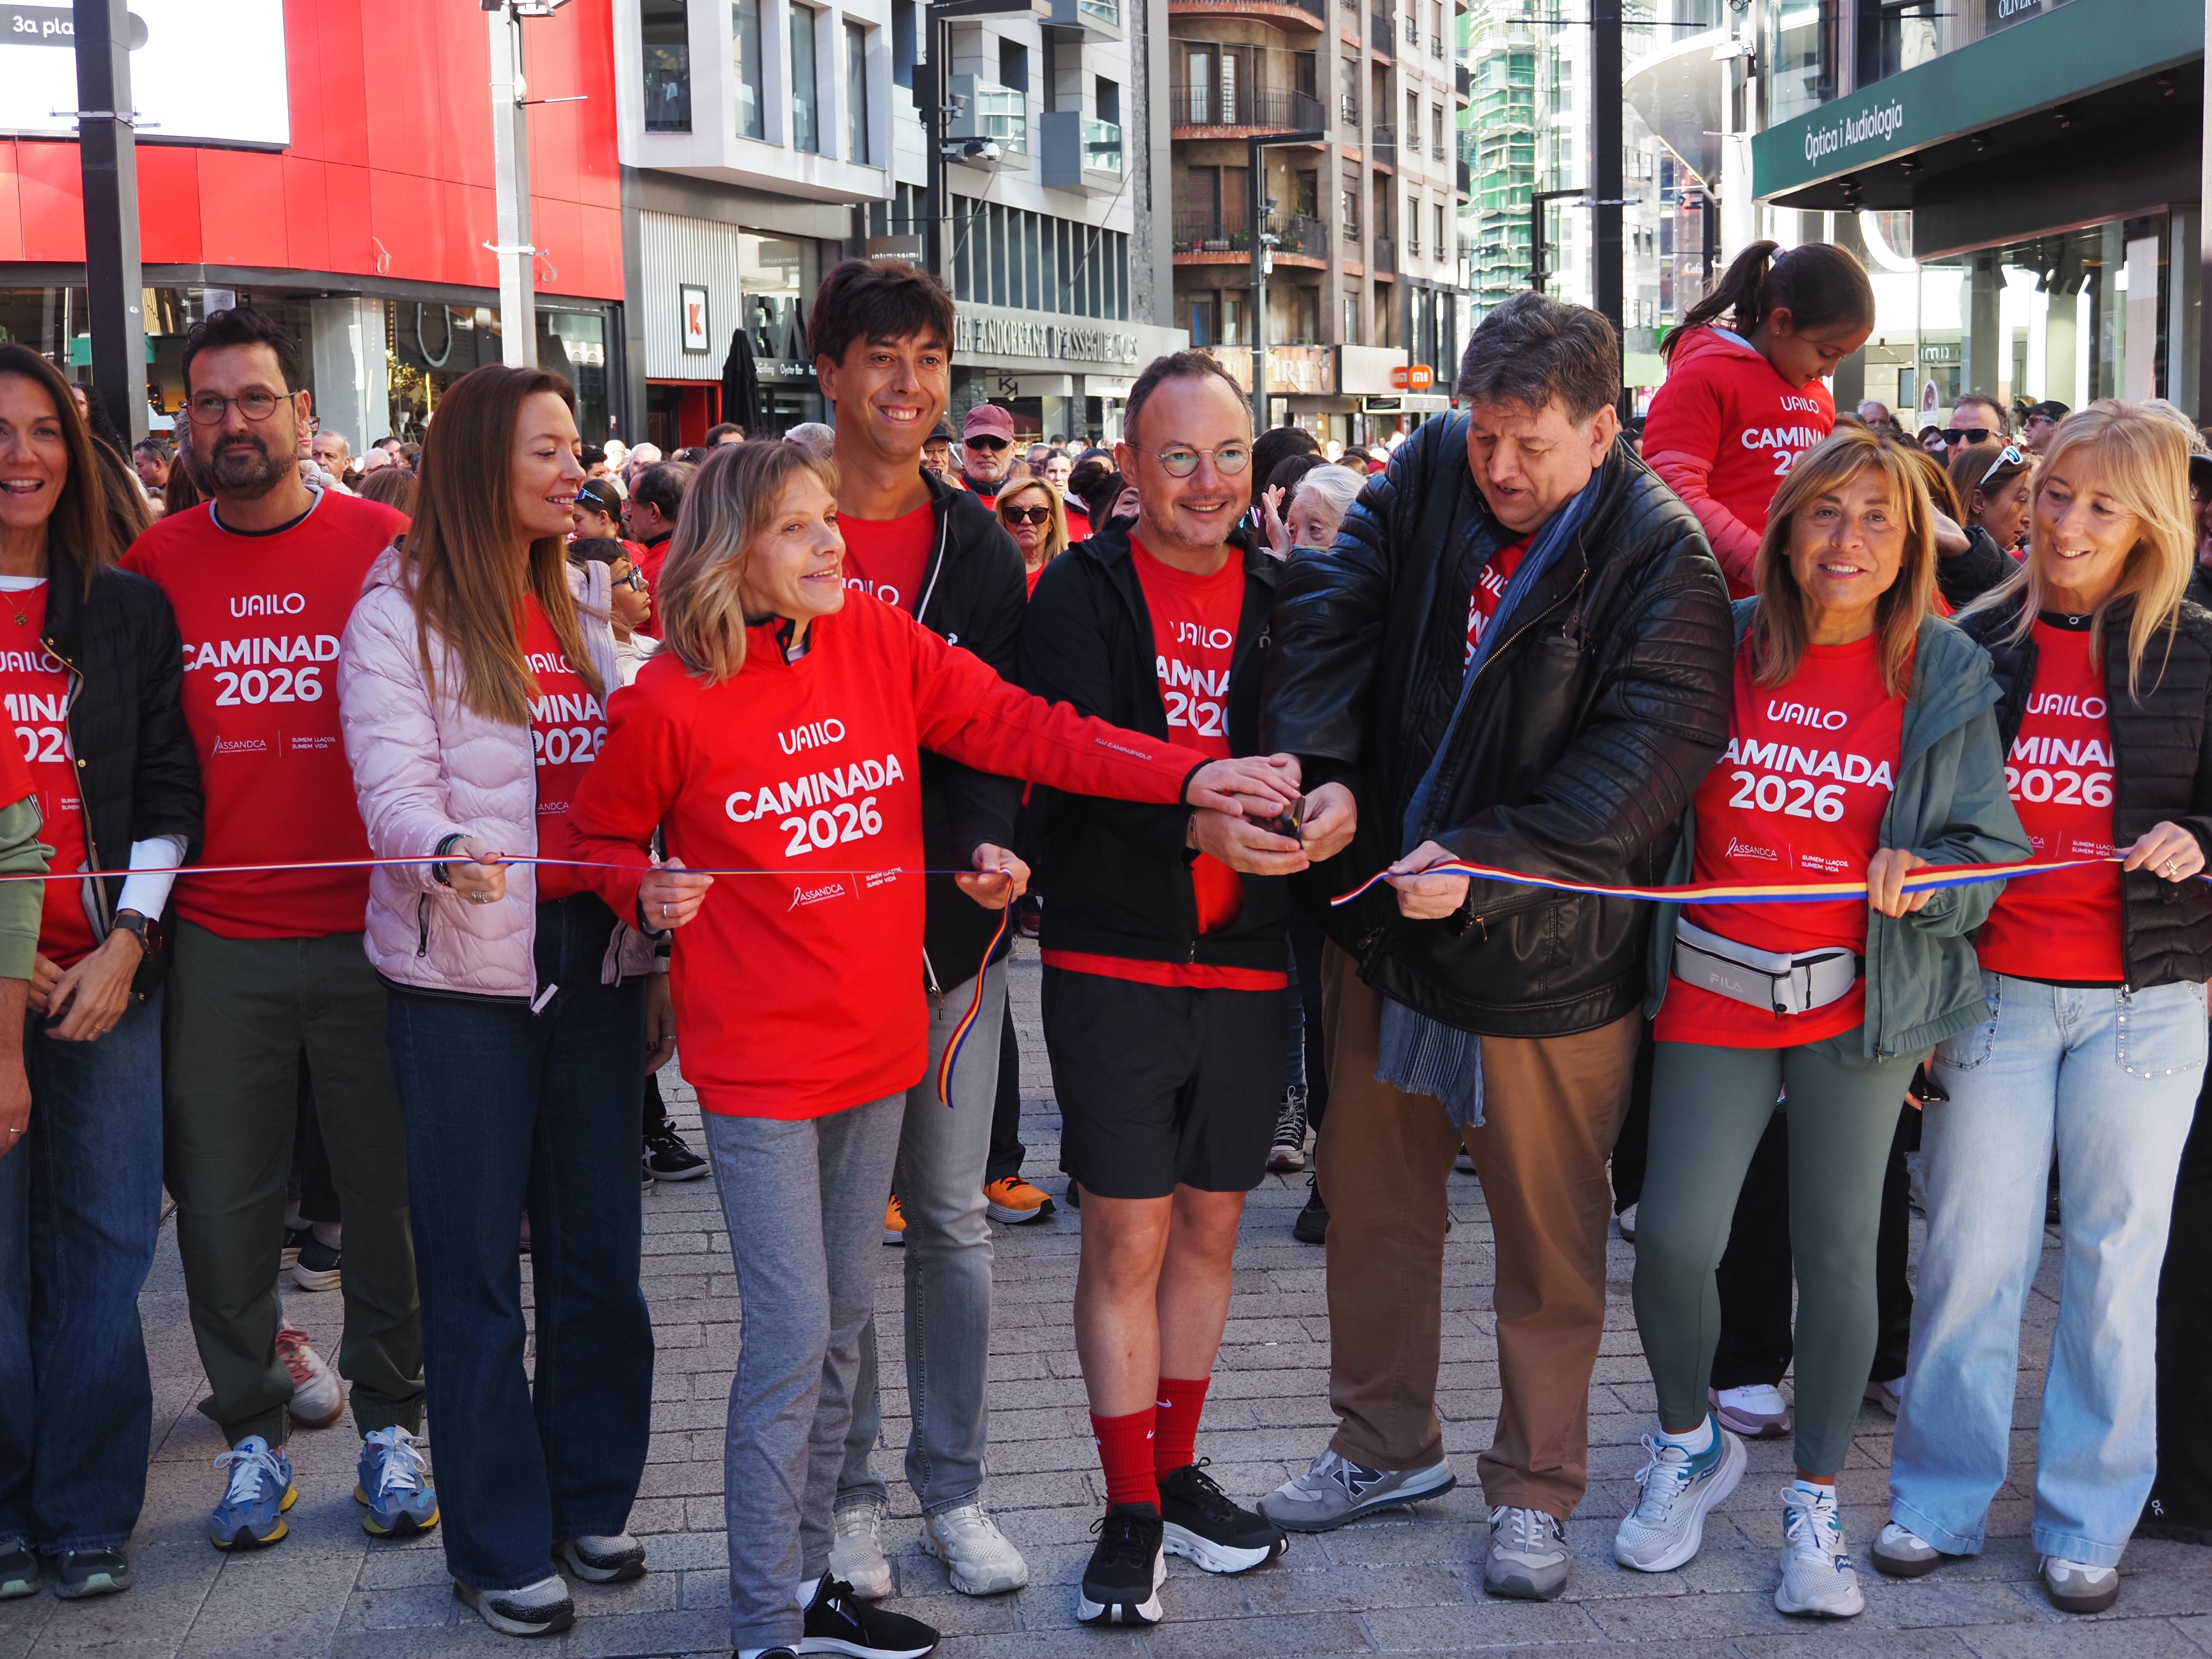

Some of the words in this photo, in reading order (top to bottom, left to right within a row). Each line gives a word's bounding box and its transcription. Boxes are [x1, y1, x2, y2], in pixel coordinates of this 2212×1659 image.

[13, 16, 38, 33] 3a
[1805, 125, 1837, 166] Òptica
[1839, 119, 1842, 148] i
[1845, 99, 1902, 146] Audiologia
[689, 303, 702, 336] K
[976, 318, 1049, 358] ANDORRANA
[780, 364, 795, 376] Oyster
[1780, 396, 1819, 414] UAILO
[231, 593, 305, 617] UAILO
[214, 667, 323, 706] 2026
[1767, 700, 1847, 730] UAILO
[2026, 693, 2107, 719] UAILO
[218, 740, 266, 750] ASSANDCA
[778, 719, 845, 754] UAILO
[725, 754, 905, 823] CAMINADA
[1729, 771, 1846, 822] 2026
[2004, 767, 2113, 808] 2026
[780, 797, 883, 858] 2026
[1734, 845, 1777, 857] ASSANDCA
[800, 884, 844, 902] ASSANDCA
[884, 875, 897, 883] VIDA
[1710, 973, 1743, 993] FILA
